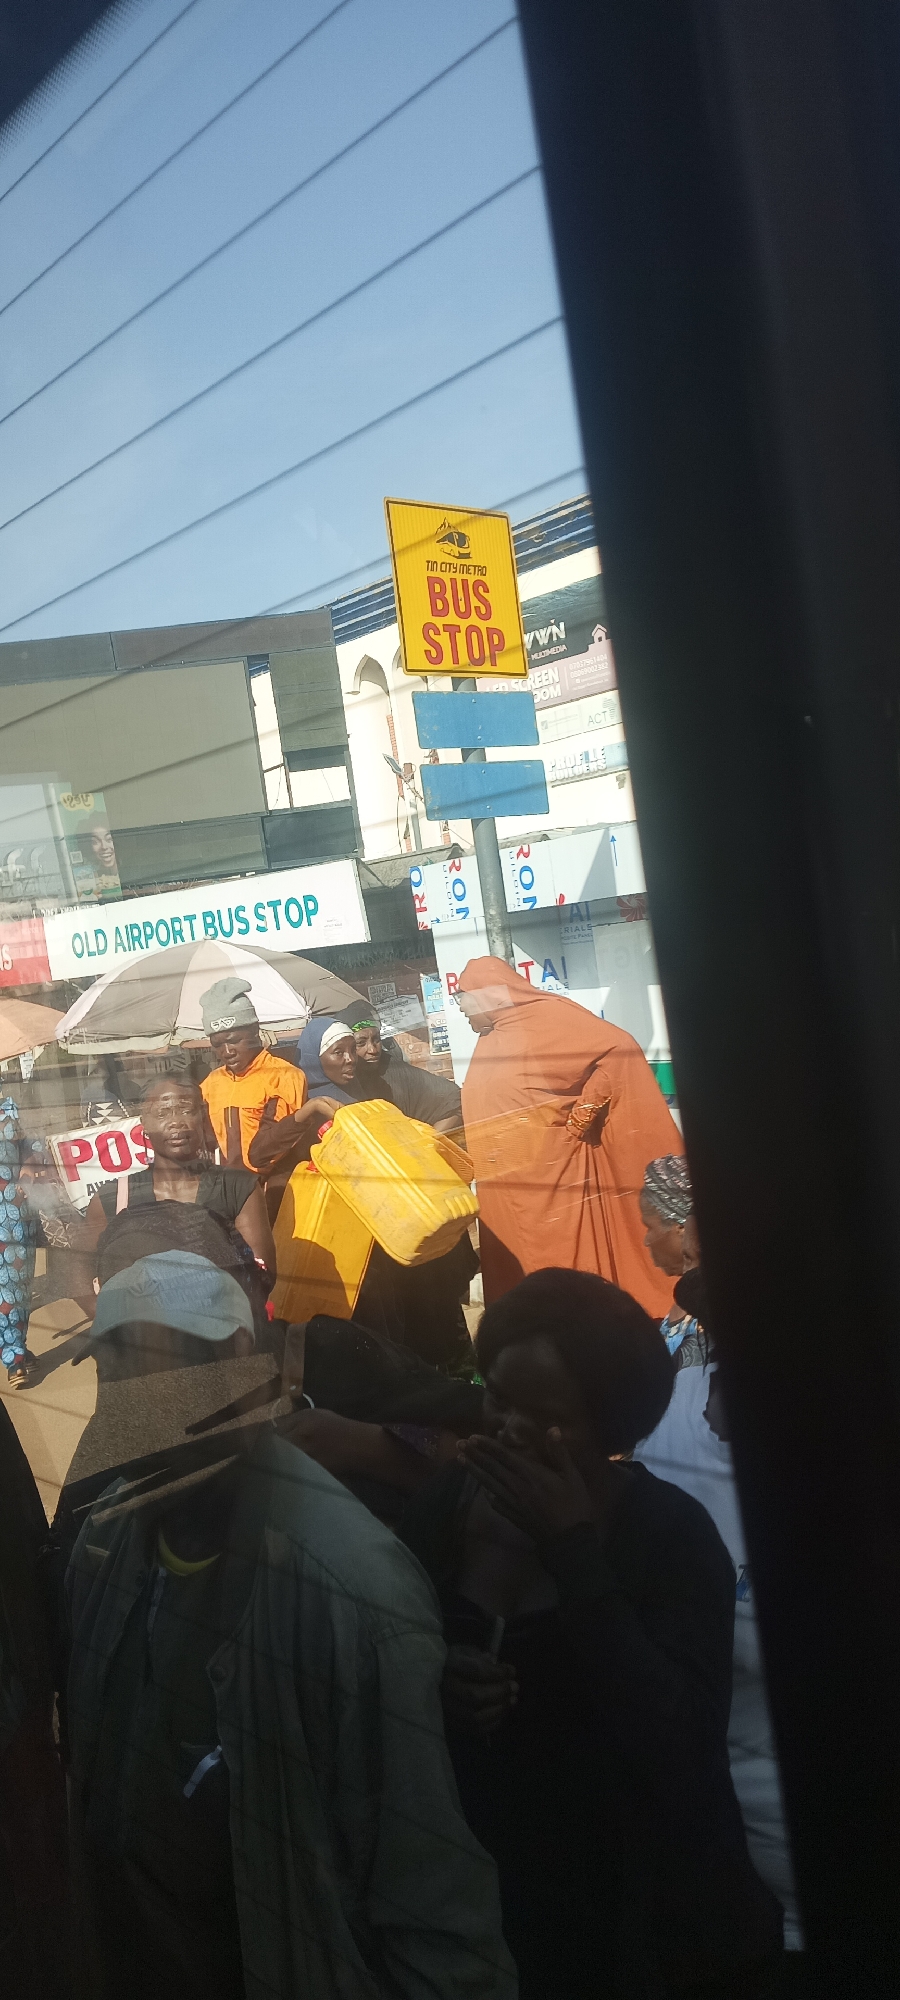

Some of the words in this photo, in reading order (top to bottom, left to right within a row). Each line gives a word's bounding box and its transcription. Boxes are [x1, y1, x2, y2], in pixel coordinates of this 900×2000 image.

[425, 560, 438, 572] TIN
[440, 561, 458, 574] CITY
[459, 563, 487, 577] METRO
[426, 575, 492, 621] BUS
[422, 621, 506, 667] STOP
[531, 644, 568, 660] MULTIMEDIA
[511, 667, 560, 692] SCREEN
[587, 710, 607, 727] ACT
[549, 759, 607, 782] BUILDERS
[71, 928, 108, 959] OLD
[114, 914, 197, 954] AIRPORT
[202, 904, 250, 940] BUS
[254, 894, 319, 934] STOP
